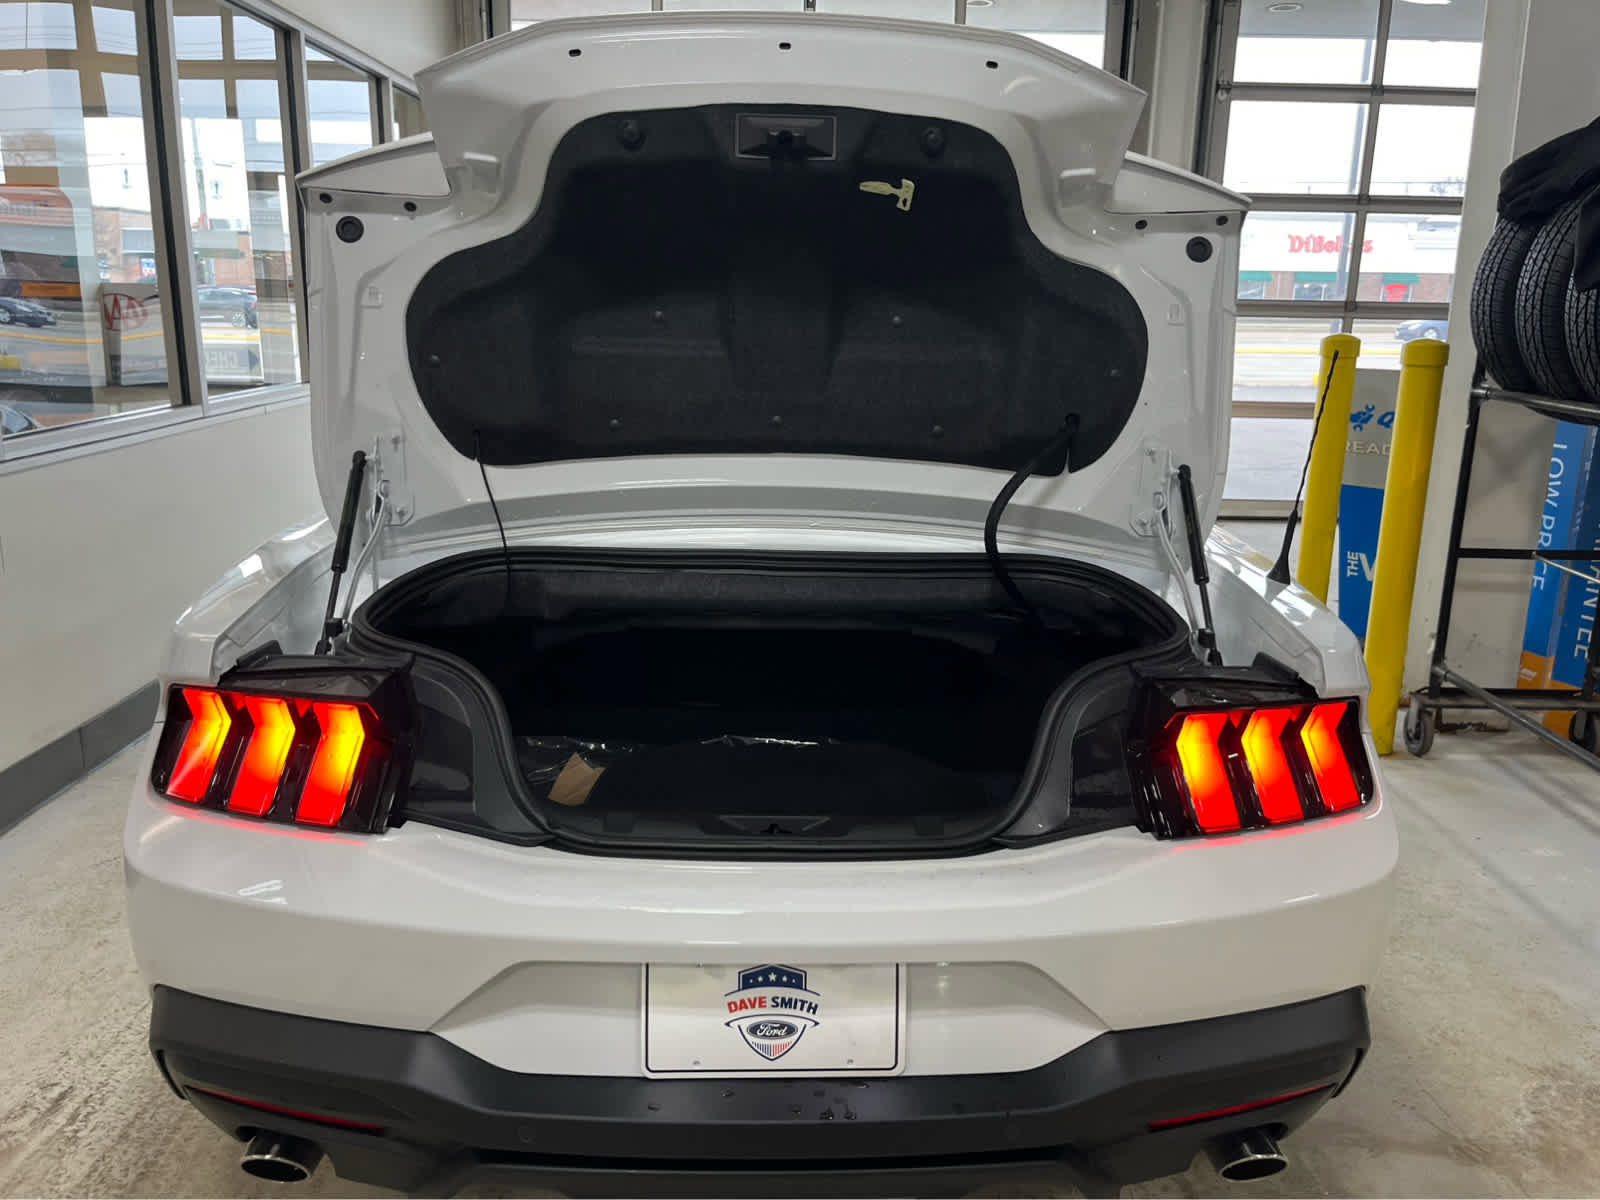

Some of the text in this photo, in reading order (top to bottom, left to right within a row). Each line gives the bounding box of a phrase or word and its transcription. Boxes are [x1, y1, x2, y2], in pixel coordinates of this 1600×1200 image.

[1533, 514, 1556, 591] PRCE
[1347, 551, 1360, 577] THE
[727, 996, 819, 1015] DAVE SMITH
[756, 1022, 788, 1037] Ford
